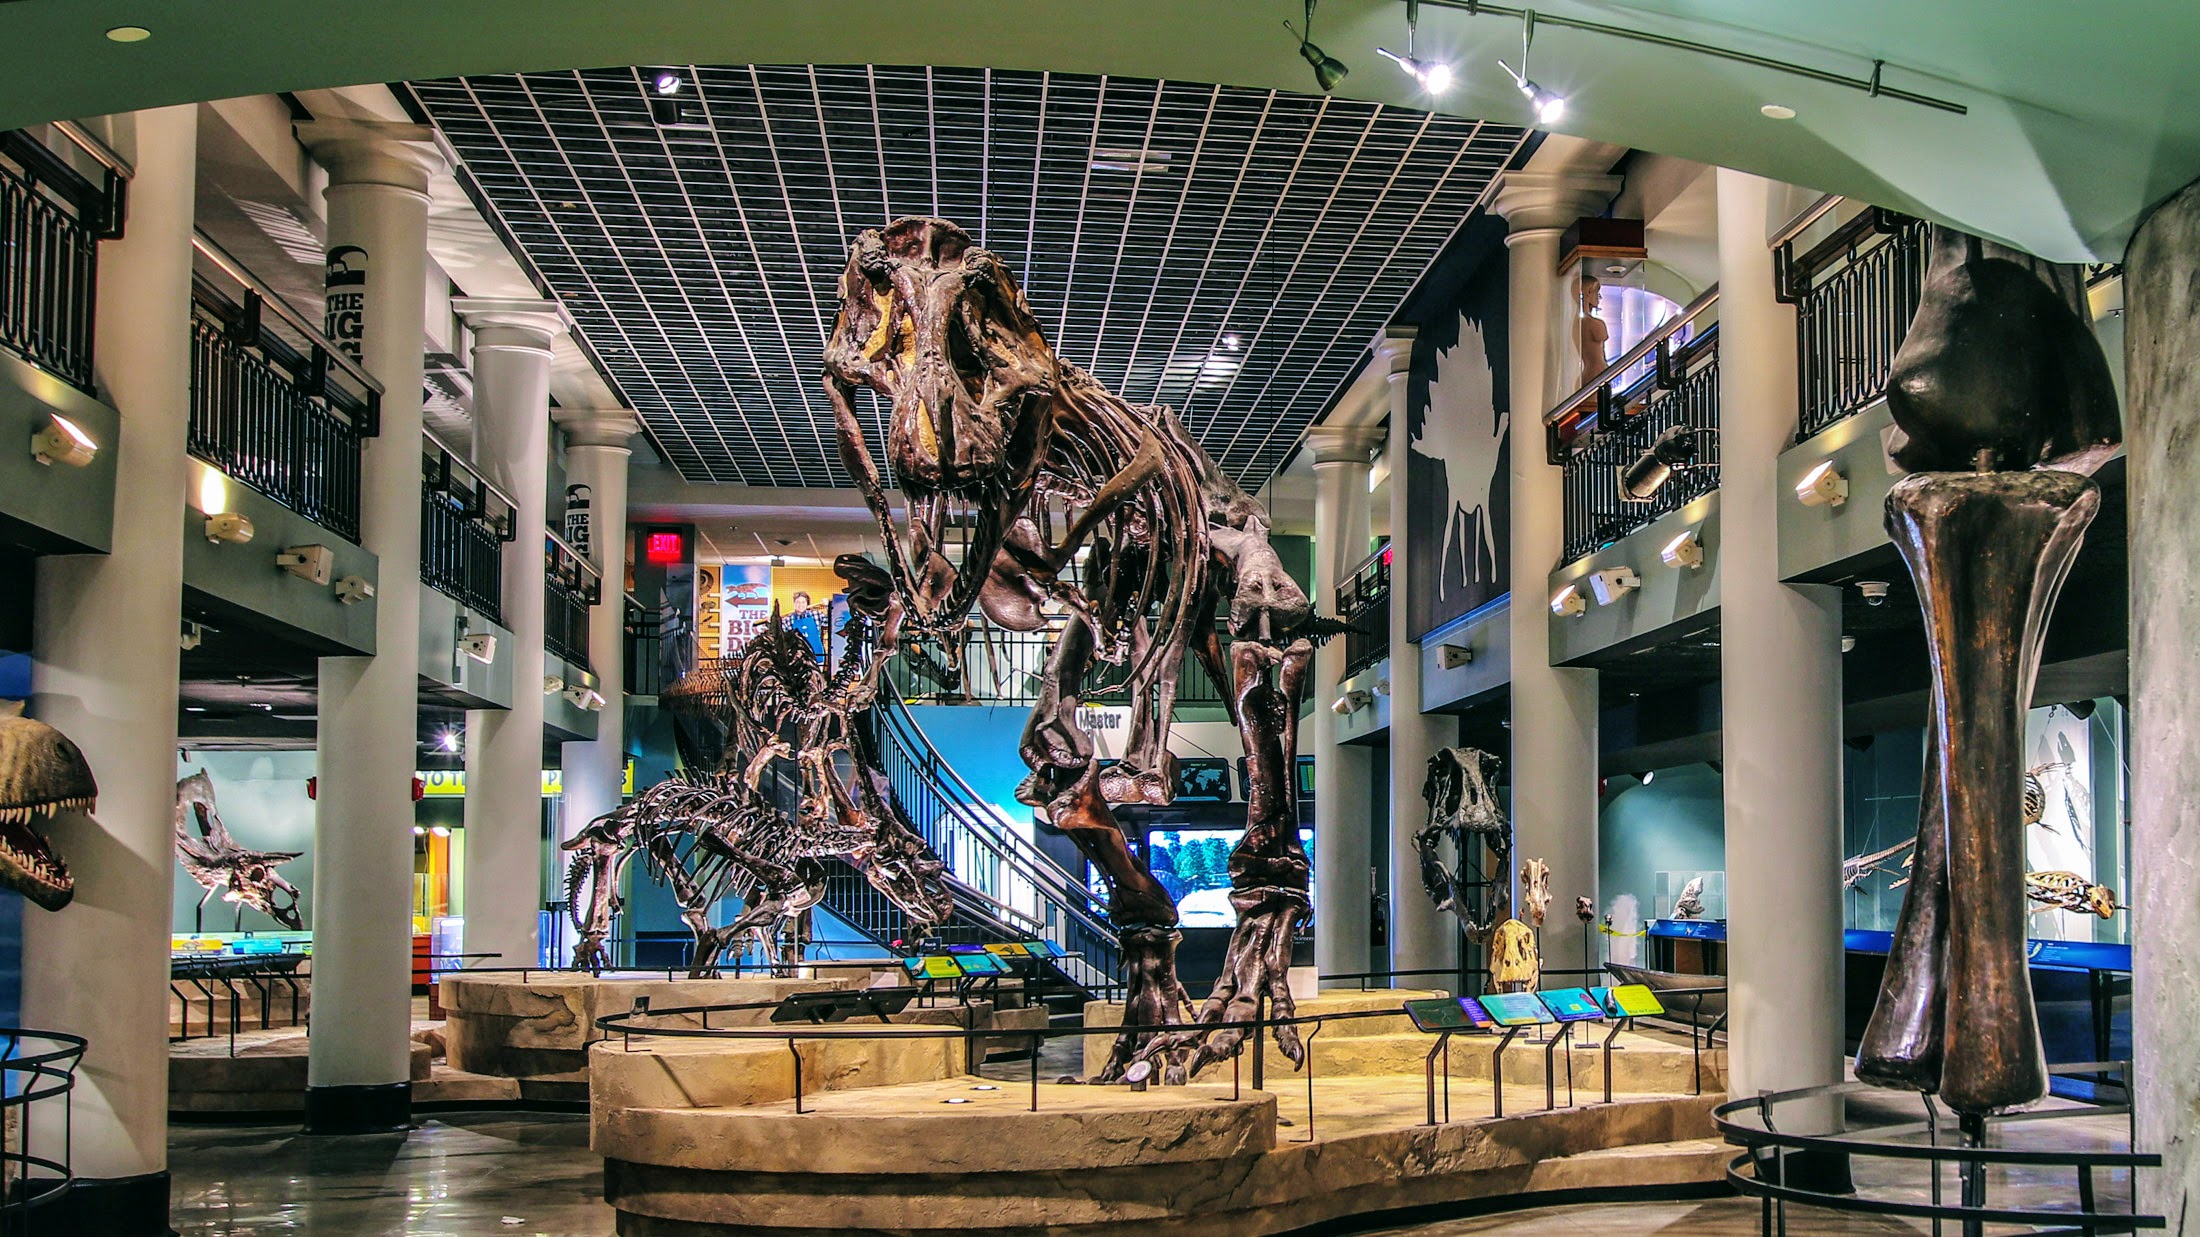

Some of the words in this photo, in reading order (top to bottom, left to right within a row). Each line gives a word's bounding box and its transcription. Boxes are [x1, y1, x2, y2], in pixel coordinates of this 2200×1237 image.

[327, 293, 364, 312] THE
[567, 514, 589, 525] THE
[653, 534, 677, 551] EXIT
[739, 609, 768, 619] THE
[1079, 710, 1121, 729] Master
[421, 771, 444, 786] TO
